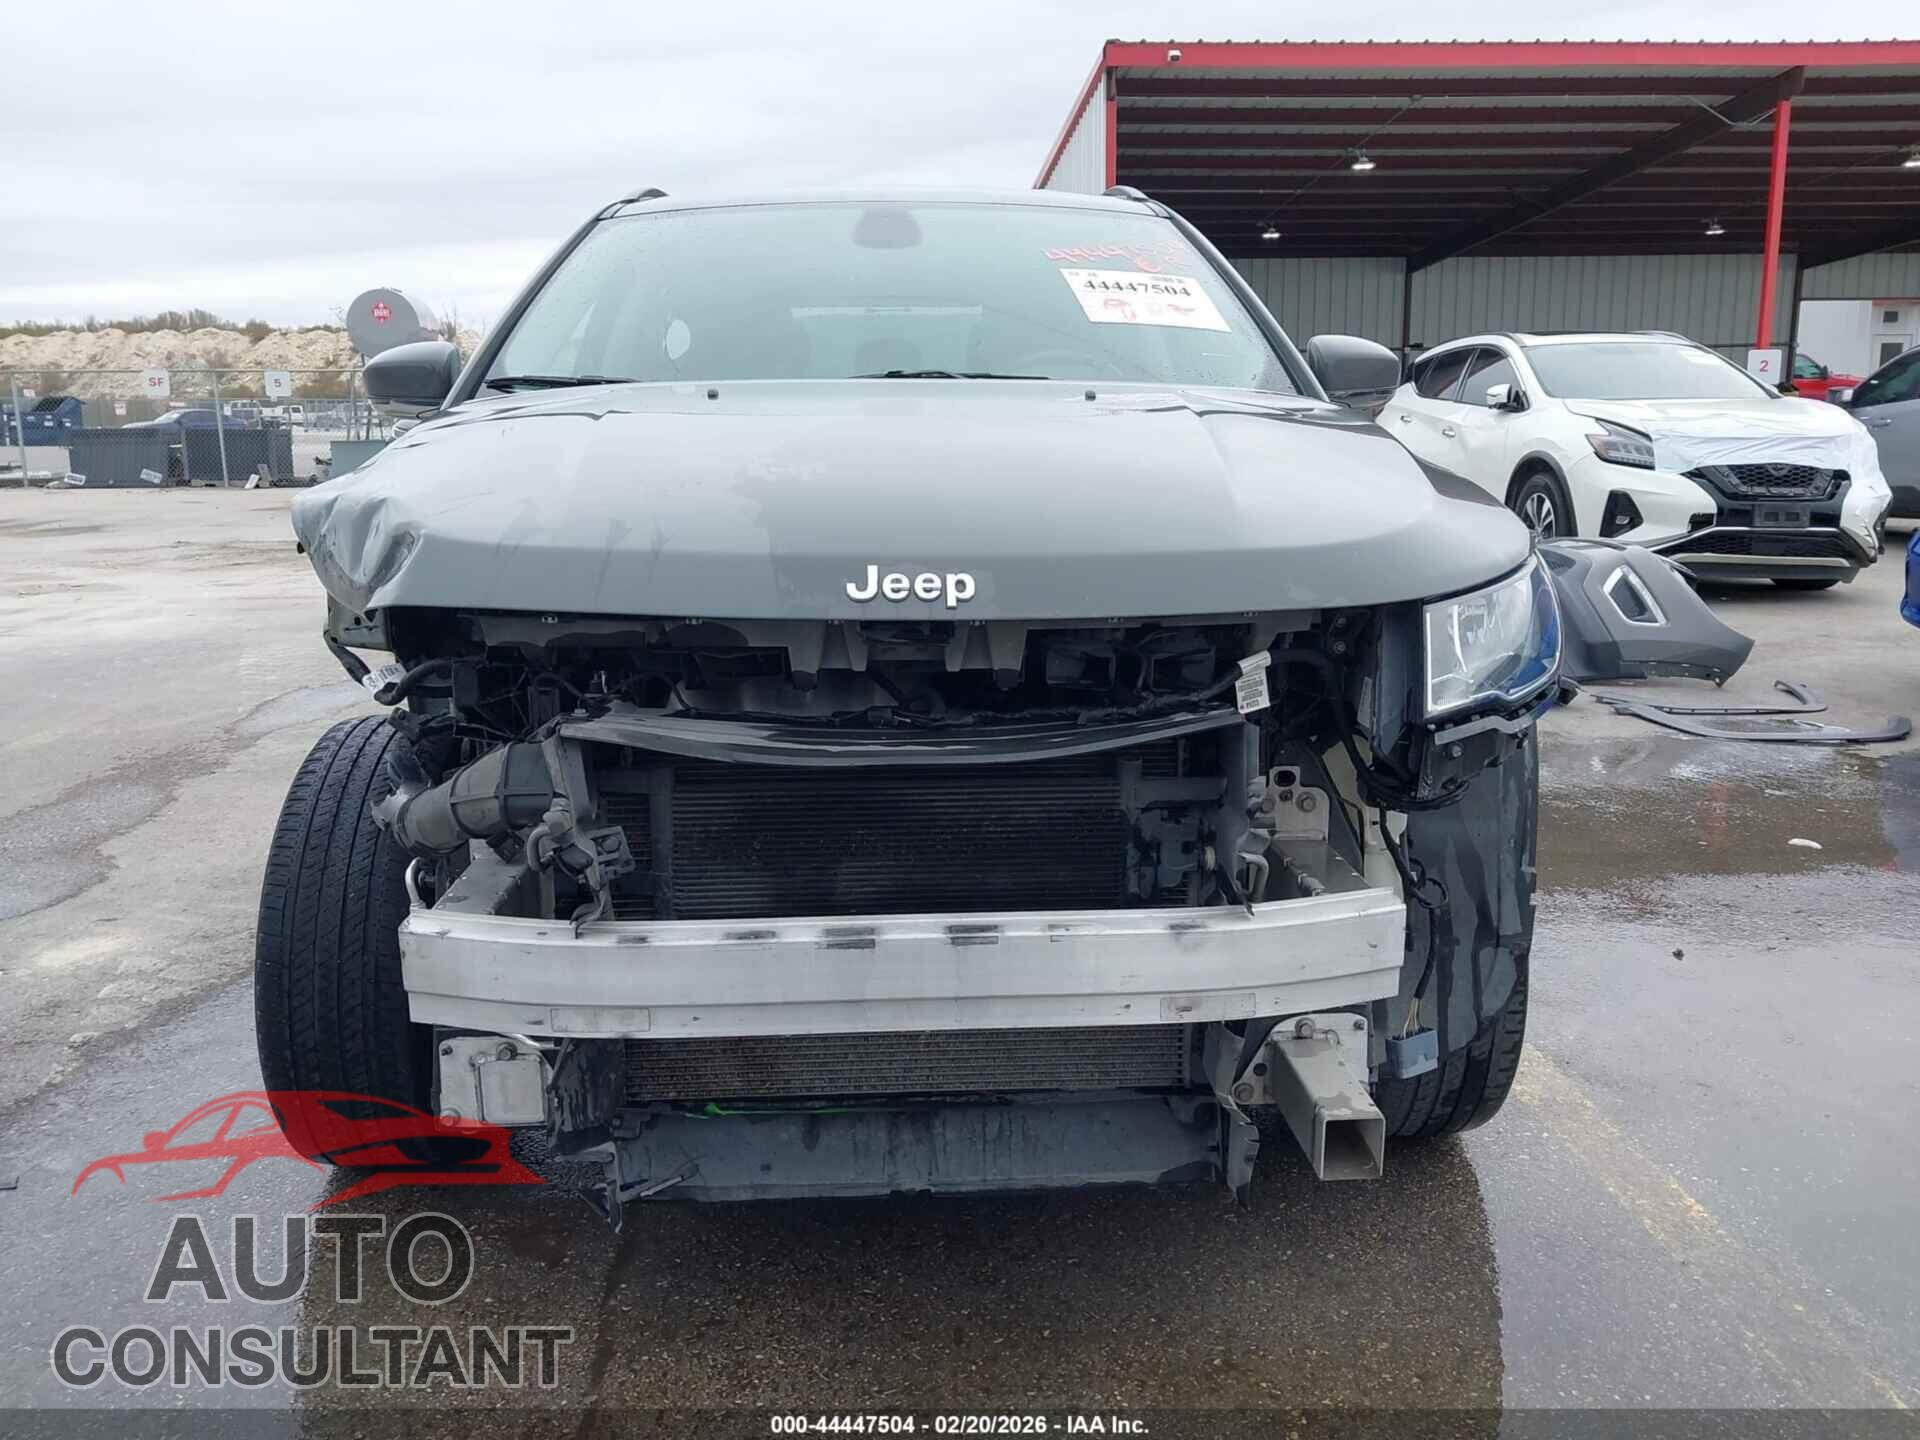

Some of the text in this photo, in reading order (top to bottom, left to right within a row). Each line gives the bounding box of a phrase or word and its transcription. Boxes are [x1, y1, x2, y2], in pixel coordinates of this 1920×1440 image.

[1083, 280, 1192, 297] 44447504
[1759, 359, 1769, 373] 2
[148, 376, 164, 388] SF
[273, 378, 283, 389] 5
[846, 564, 976, 609] Jeep
